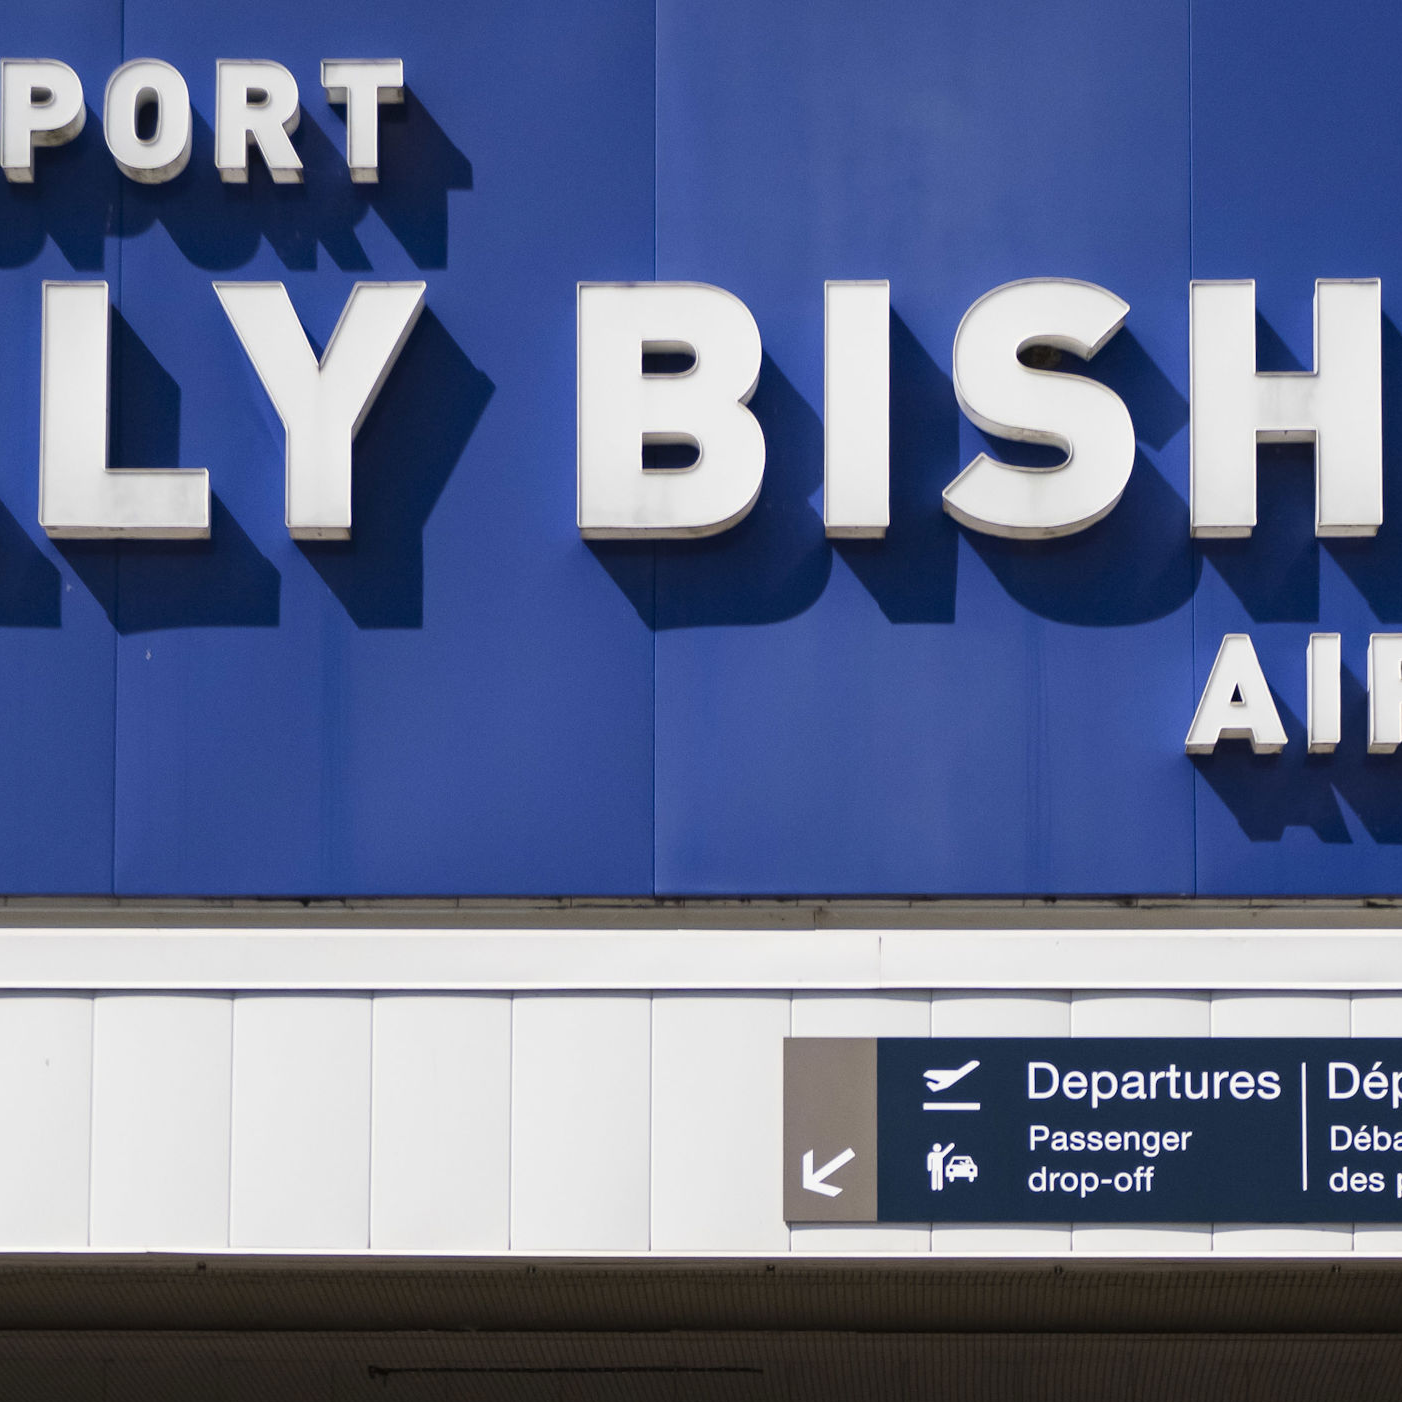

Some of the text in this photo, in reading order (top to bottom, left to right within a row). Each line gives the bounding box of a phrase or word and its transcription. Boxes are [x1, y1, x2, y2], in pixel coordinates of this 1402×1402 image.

[1028, 1062, 1281, 1108] Departures
[1030, 1125, 1192, 1157] Passenger
[1028, 1166, 1154, 1198] drop-off
[1329, 1166, 1385, 1193] des
